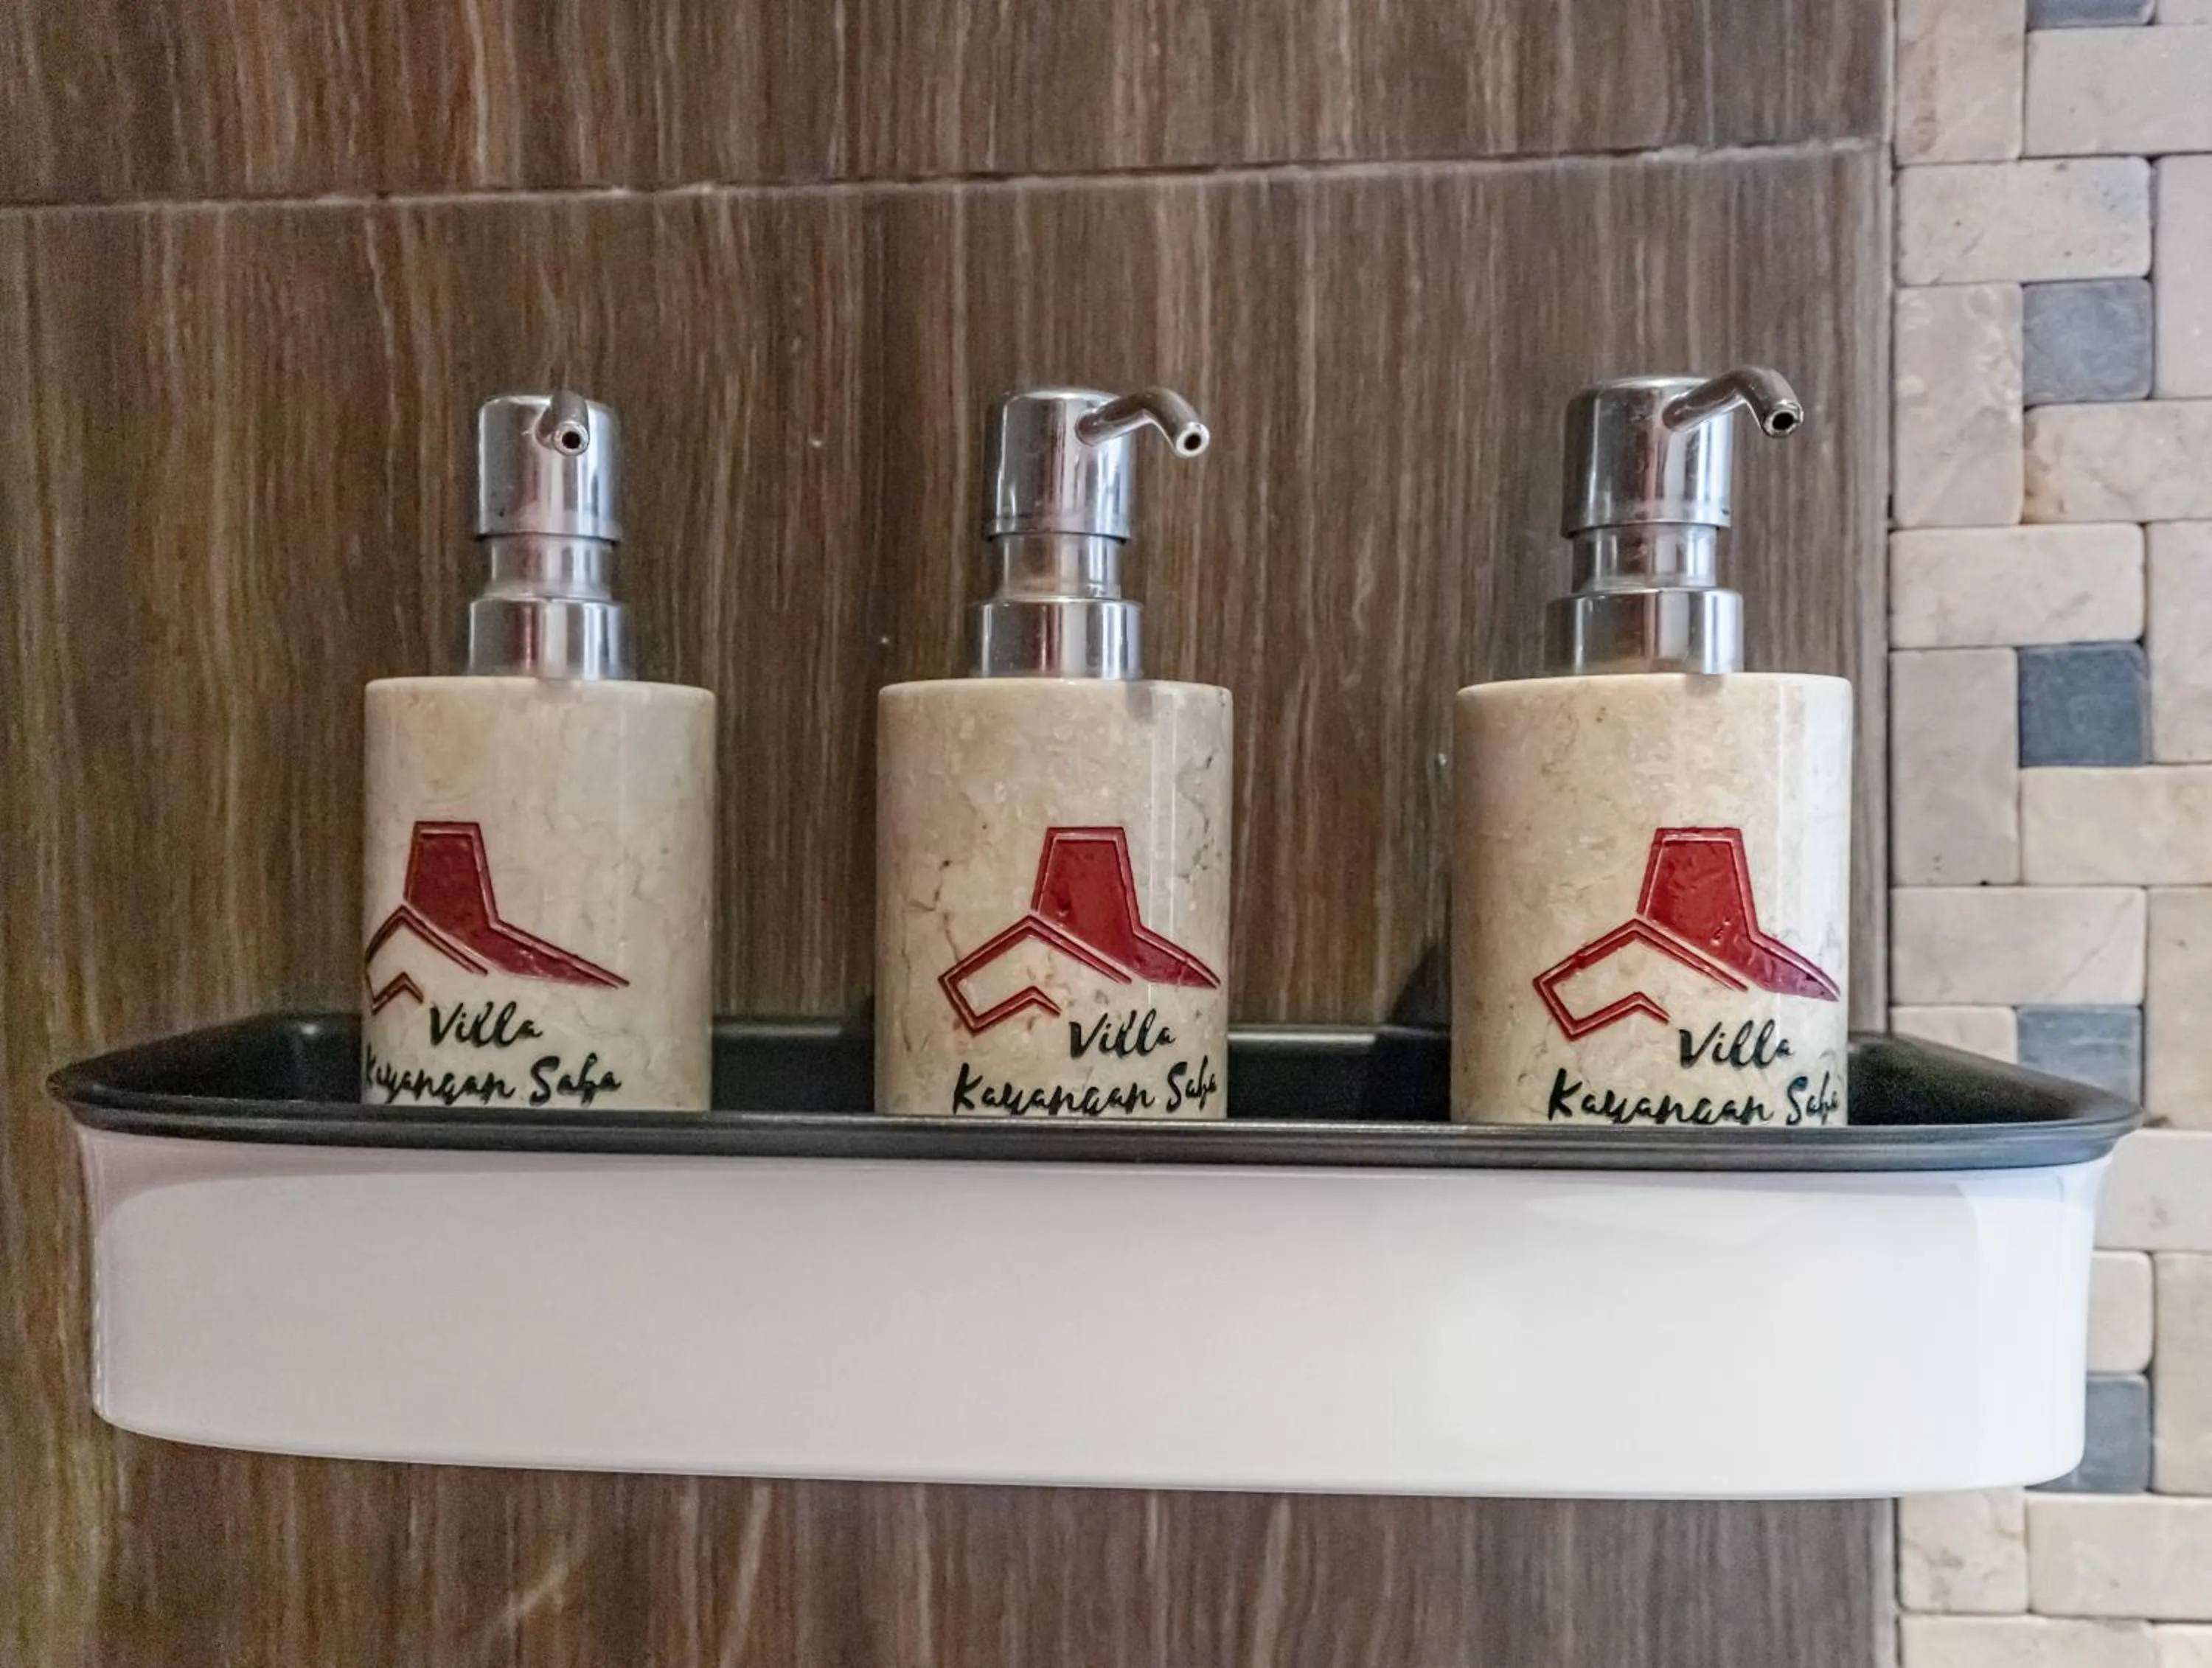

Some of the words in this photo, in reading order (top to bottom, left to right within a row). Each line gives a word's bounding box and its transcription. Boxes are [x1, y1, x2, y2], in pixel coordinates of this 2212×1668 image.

[429, 1001, 543, 1048] Villa
[1068, 1008, 1177, 1060] Villa
[1678, 1018, 1796, 1069] Villa
